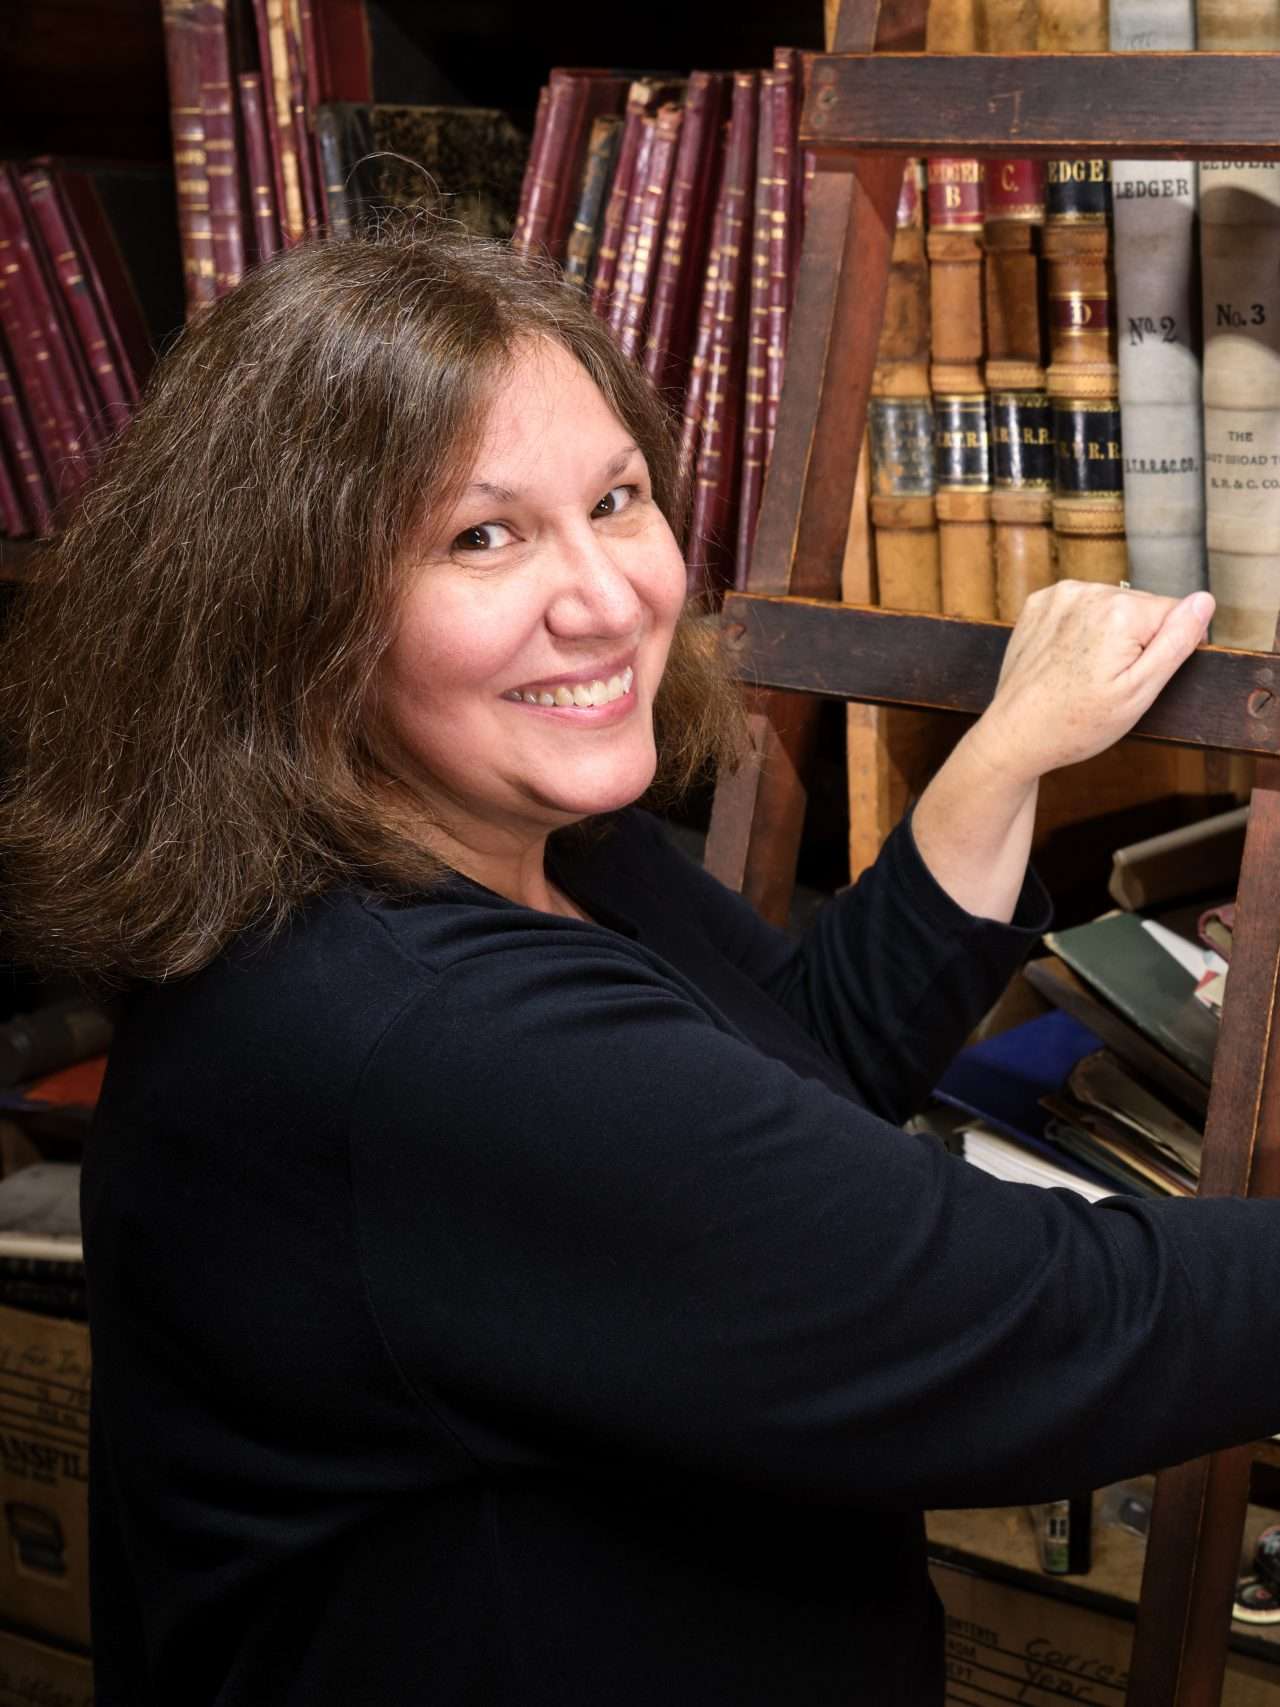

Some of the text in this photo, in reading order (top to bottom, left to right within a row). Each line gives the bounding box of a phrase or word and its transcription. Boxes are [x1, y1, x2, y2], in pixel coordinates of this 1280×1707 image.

[944, 185, 961, 208] B
[1115, 179, 1190, 199] LEDGER
[1216, 303, 1266, 327] No. 3
[1160, 316, 1178, 344] 2
[1228, 431, 1253, 442] THE
